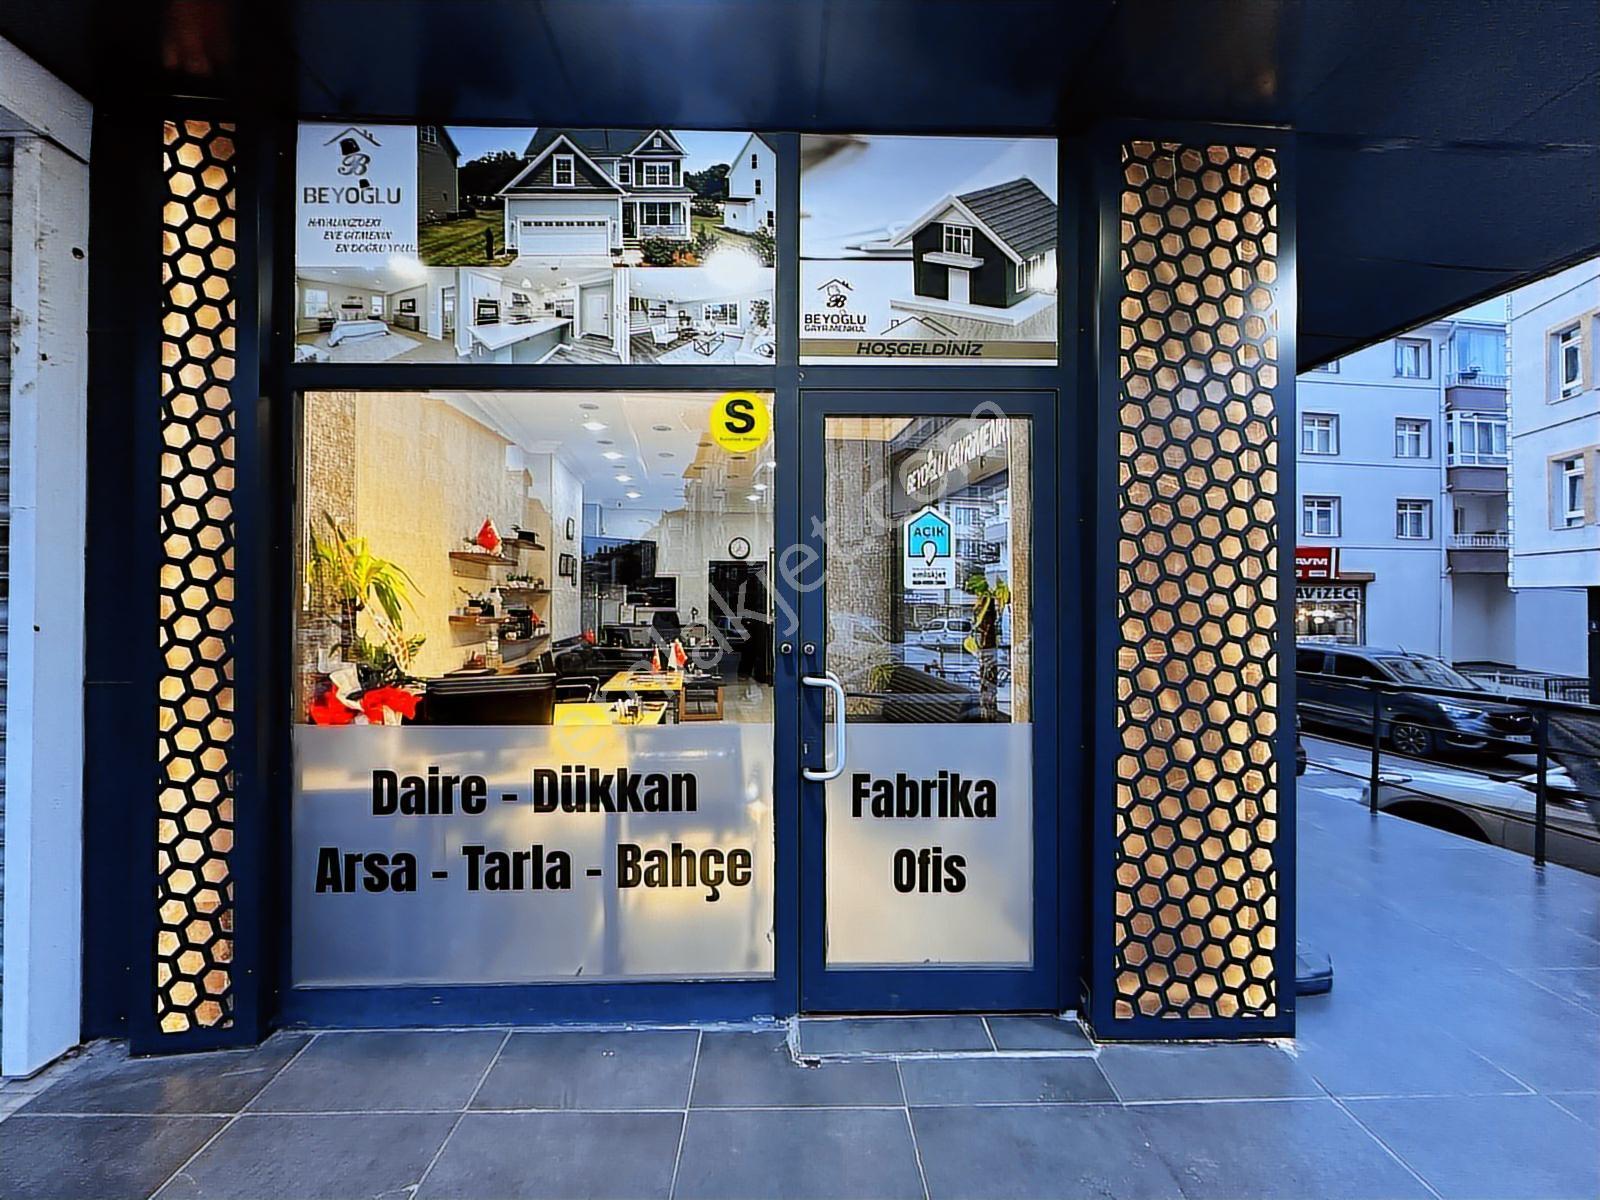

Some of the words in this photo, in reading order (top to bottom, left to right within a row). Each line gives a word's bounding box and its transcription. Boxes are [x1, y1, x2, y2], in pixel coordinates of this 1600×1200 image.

[856, 340, 984, 357] HOŞGELDİNİZ
[725, 399, 756, 434] S
[372, 767, 488, 815] Daire
[533, 765, 698, 813] Dükkan
[852, 770, 998, 818] Fabrika
[315, 847, 417, 893] Arsa
[462, 844, 572, 891] Tarla
[617, 843, 753, 902] Bahçe
[893, 847, 967, 893] Ofis
